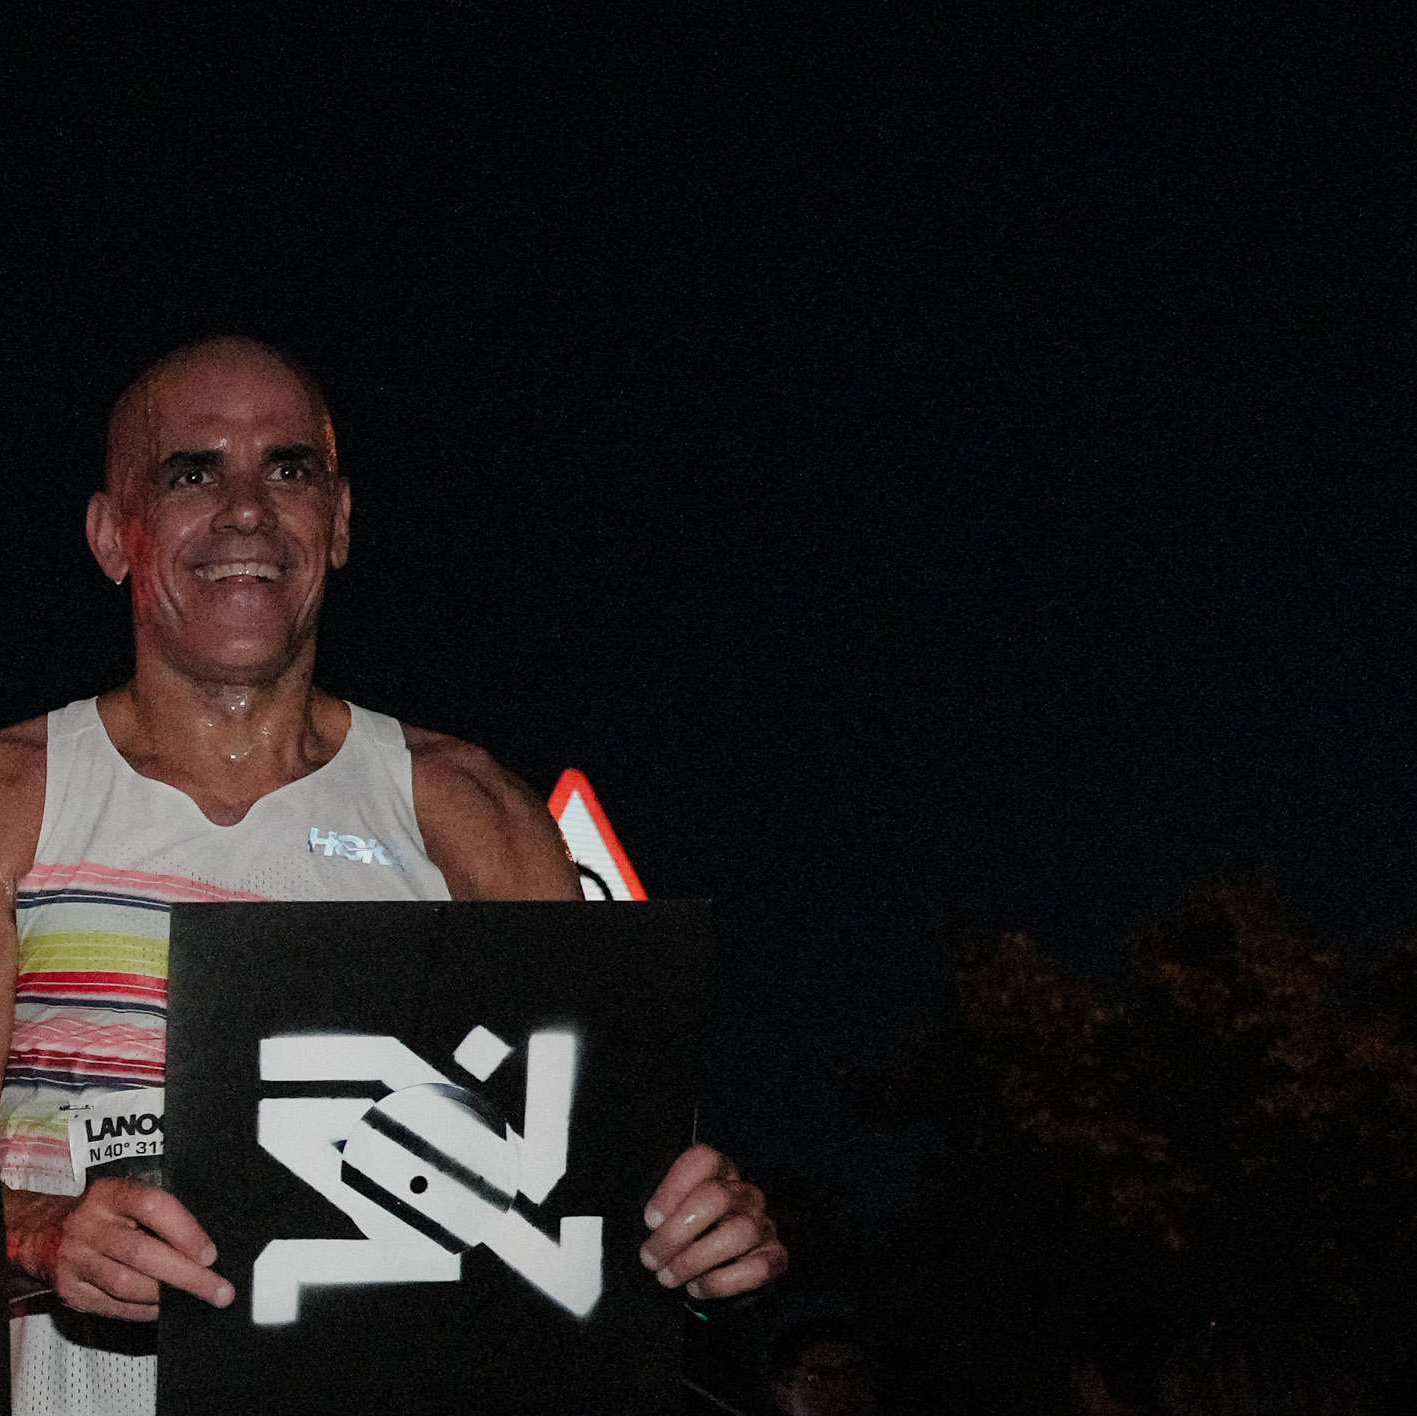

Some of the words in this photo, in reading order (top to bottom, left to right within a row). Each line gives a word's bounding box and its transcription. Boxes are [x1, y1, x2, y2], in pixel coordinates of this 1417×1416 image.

[85, 1114, 165, 1142] LANO
[89, 1147, 101, 1162] N
[104, 1142, 131, 1158] 40°
